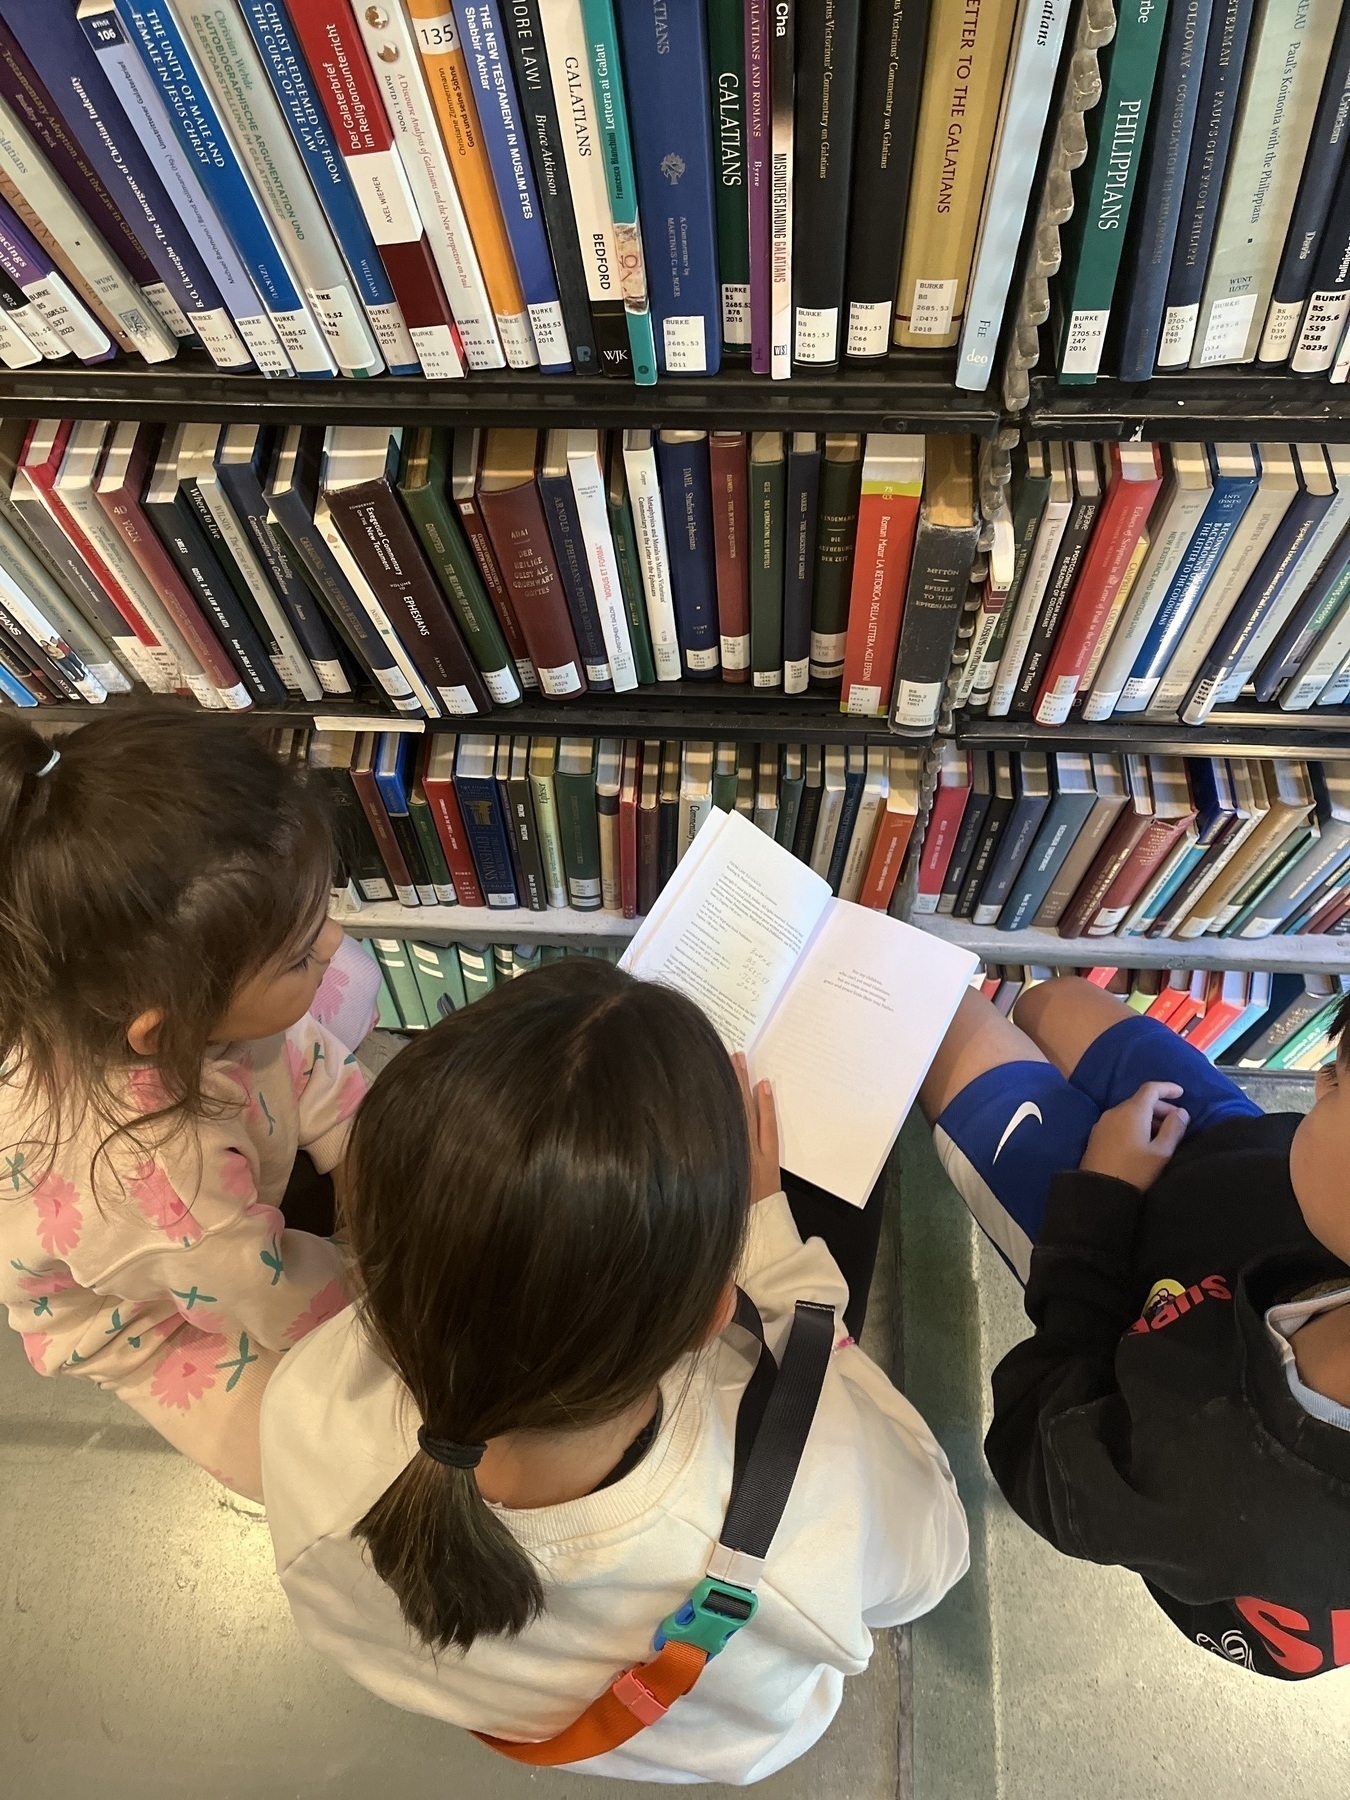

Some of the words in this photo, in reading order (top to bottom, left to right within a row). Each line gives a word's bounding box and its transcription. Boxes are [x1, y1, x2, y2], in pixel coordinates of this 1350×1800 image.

[479, 4, 493, 29] THE
[776, 2, 788, 36] Cha
[824, 0, 836, 19] rius
[960, 0, 980, 48] ETTER
[1137, 0, 1153, 23] rbe
[98, 28, 117, 42] 106
[131, 12, 163, 64] FEMALE
[420, 24, 454, 46] 135
[750, 0, 760, 59] ALATIANS
[823, 20, 834, 69] Victorinus'
[214, 9, 238, 56] Christian
[234, 57, 253, 90] Wehde
[465, 6, 483, 50] Shabbir
[475, 53, 490, 90] Akhtar
[484, 32, 499, 59] NEW
[594, 43, 608, 76] Galati
[1283, 40, 1301, 74] Paul's
[156, 66, 171, 82] IN
[252, 3, 270, 32] THE
[264, 34, 287, 77] CURSE
[281, 79, 296, 97] OF
[289, 99, 306, 124] THE
[300, 127, 317, 152] LAW
[325, 23, 370, 132] Religionsunterricht
[448, 65, 462, 96] Söhne
[520, 46, 541, 90] LAW!
[752, 64, 760, 87] AND
[956, 55, 972, 79] TO
[70, 76, 99, 120] Indentity
[146, 8, 166, 38] THE
[160, 40, 186, 81] UNITY
[180, 84, 196, 102] OF
[189, 104, 212, 138] MALE
[205, 140, 225, 168] AND
[264, 1, 291, 51] CHRIST
[284, 55, 318, 125] REDEEMED
[320, 149, 341, 184] FROM
[322, 62, 354, 128] Galaterbrief
[438, 67, 456, 118] Zimmermann
[491, 62, 514, 130] TESTAMENT
[599, 79, 610, 89] ai
[820, 71, 832, 126] Commentary
[163, 84, 188, 118] JESUS
[384, 75, 397, 100] DAVID
[395, 110, 407, 132] YOON
[456, 96, 466, 112] seine
[564, 56, 592, 156] GALATIANS
[602, 92, 615, 129] Lettera
[752, 92, 761, 136] ROMANS
[950, 85, 968, 117] THE
[1272, 76, 1293, 124] Koinonia
[201, 13, 258, 131] AUTOBIOGRAPHISCHE
[253, 133, 295, 218] ARGUMENTATION
[290, 219, 305, 241] UND
[460, 114, 470, 130] und
[535, 114, 549, 145] Bruce
[717, 72, 742, 186] GALATIANS
[820, 128, 828, 139] on
[1266, 126, 1281, 149] with
[94, 120, 123, 163] Christian
[182, 119, 211, 165] CHRIST
[347, 129, 362, 149] Der
[363, 133, 375, 148] im
[452, 120, 466, 156] Christiane
[465, 130, 474, 147] Gott
[506, 133, 518, 145] IN
[607, 132, 618, 164] Bianchini
[117, 164, 129, 174] of
[509, 147, 527, 189] MUSLIM
[541, 148, 558, 195] Atkinson
[752, 161, 762, 186] Byrne
[819, 141, 829, 178] Galatians
[937, 123, 962, 213] GALATIANS
[1097, 99, 1141, 230] PHILIPPIANS
[1262, 151, 1276, 168] the
[371, 176, 386, 204] WIEMER
[613, 166, 623, 199] Francesco
[773, 153, 786, 238] MISUNDERSTANDING
[1250, 170, 1272, 224] Philippians
[125, 176, 156, 222] Emergence
[382, 205, 393, 223] AXEL
[519, 192, 533, 219] EYES
[152, 223, 166, 240] The
[1298, 230, 1316, 260] Davis
[165, 246, 193, 289] Ukwuegbu
[592, 233, 610, 290] BEDFORD
[774, 241, 786, 282] GALATIANS
[258, 264, 278, 299] UZUKWU
[360, 258, 379, 297] WILLIAMS
[530, 308, 553, 316] BURKE
[1315, 294, 1346, 303] BURKE
[534, 320, 562, 330] 2685.53
[978, 320, 991, 338] FEE
[1308, 314, 1340, 322] 2705.6
[1300, 344, 1328, 352] 2023g
[1304, 334, 1321, 342] B58
[603, 350, 628, 364] WJK
[966, 348, 988, 364] deo
[682, 467, 692, 487] DAHL
[188, 485, 210, 516] Where
[684, 492, 695, 514] Studies
[201, 511, 214, 525] to
[206, 520, 223, 541] Live
[879, 516, 890, 537] Roman
[1080, 504, 1096, 530] palgrave
[1199, 521, 1213, 536] THE
[365, 506, 386, 538] Exegetical
[381, 538, 403, 575] Commentary
[365, 526, 376, 541] New
[372, 540, 391, 570] Testament
[686, 522, 698, 550] Ephesians
[877, 538, 887, 557] Mazur
[1187, 537, 1205, 562] LETTER
[875, 559, 885, 568] LA
[1054, 554, 1071, 590] RE-READING
[1061, 550, 1080, 590] POSTCOLONIAL
[1182, 563, 1193, 576] TO
[871, 570, 884, 601] RETORICA
[1175, 574, 1188, 587] THE
[403, 595, 429, 636] EPHESIANS
[869, 602, 880, 621] DELLA
[1043, 596, 1059, 630] COLOSSIANS
[1053, 590, 1066, 613] AFRICAN
[1158, 588, 1182, 628] COLOSSIANS
[866, 622, 877, 646] LETTERA
[1045, 613, 1058, 638] AMERICAN
[864, 647, 874, 662] AGLI
[1028, 652, 1041, 671] Annie
[862, 661, 872, 681] EFESINI
[1021, 671, 1036, 693] Tinsley
